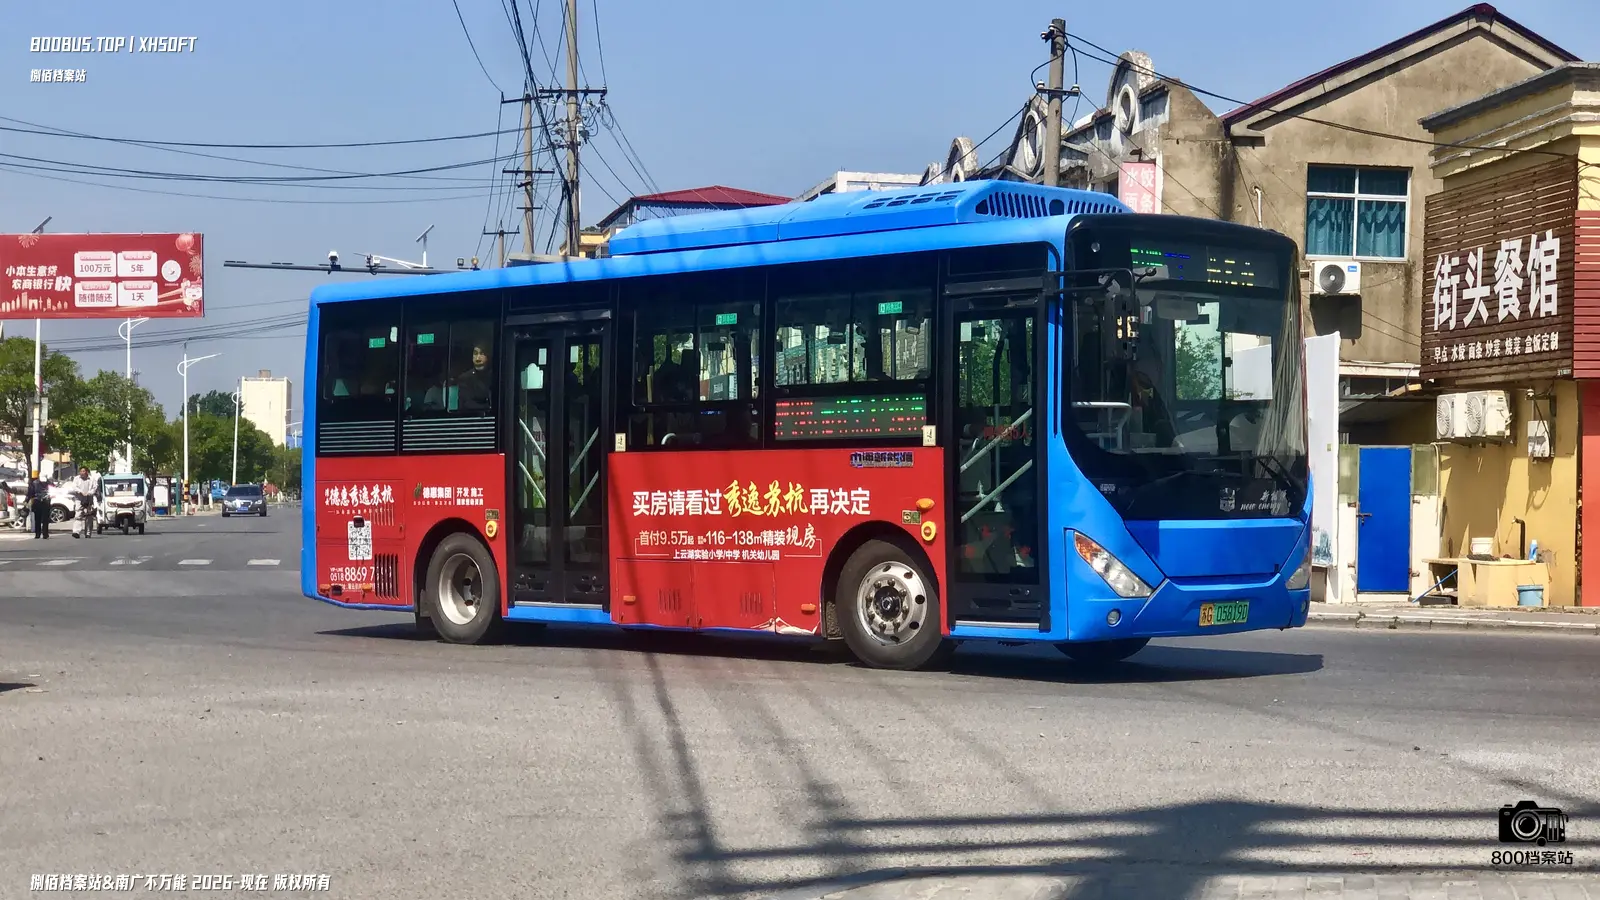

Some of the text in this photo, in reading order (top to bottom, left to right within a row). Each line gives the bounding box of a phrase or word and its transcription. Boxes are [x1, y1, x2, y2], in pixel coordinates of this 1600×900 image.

[1125, 167, 1154, 187] 水饺
[5, 265, 58, 277] 小本生意贷
[79, 263, 145, 273] 100万元 5年
[1432, 229, 1561, 331] 街头餐馆
[78, 293, 145, 303] 随借随还 1天
[1434, 331, 1559, 363] 早点 水饺 面条 炒菜 烧菜 盒饭定制
[344, 566, 368, 582] 8869
